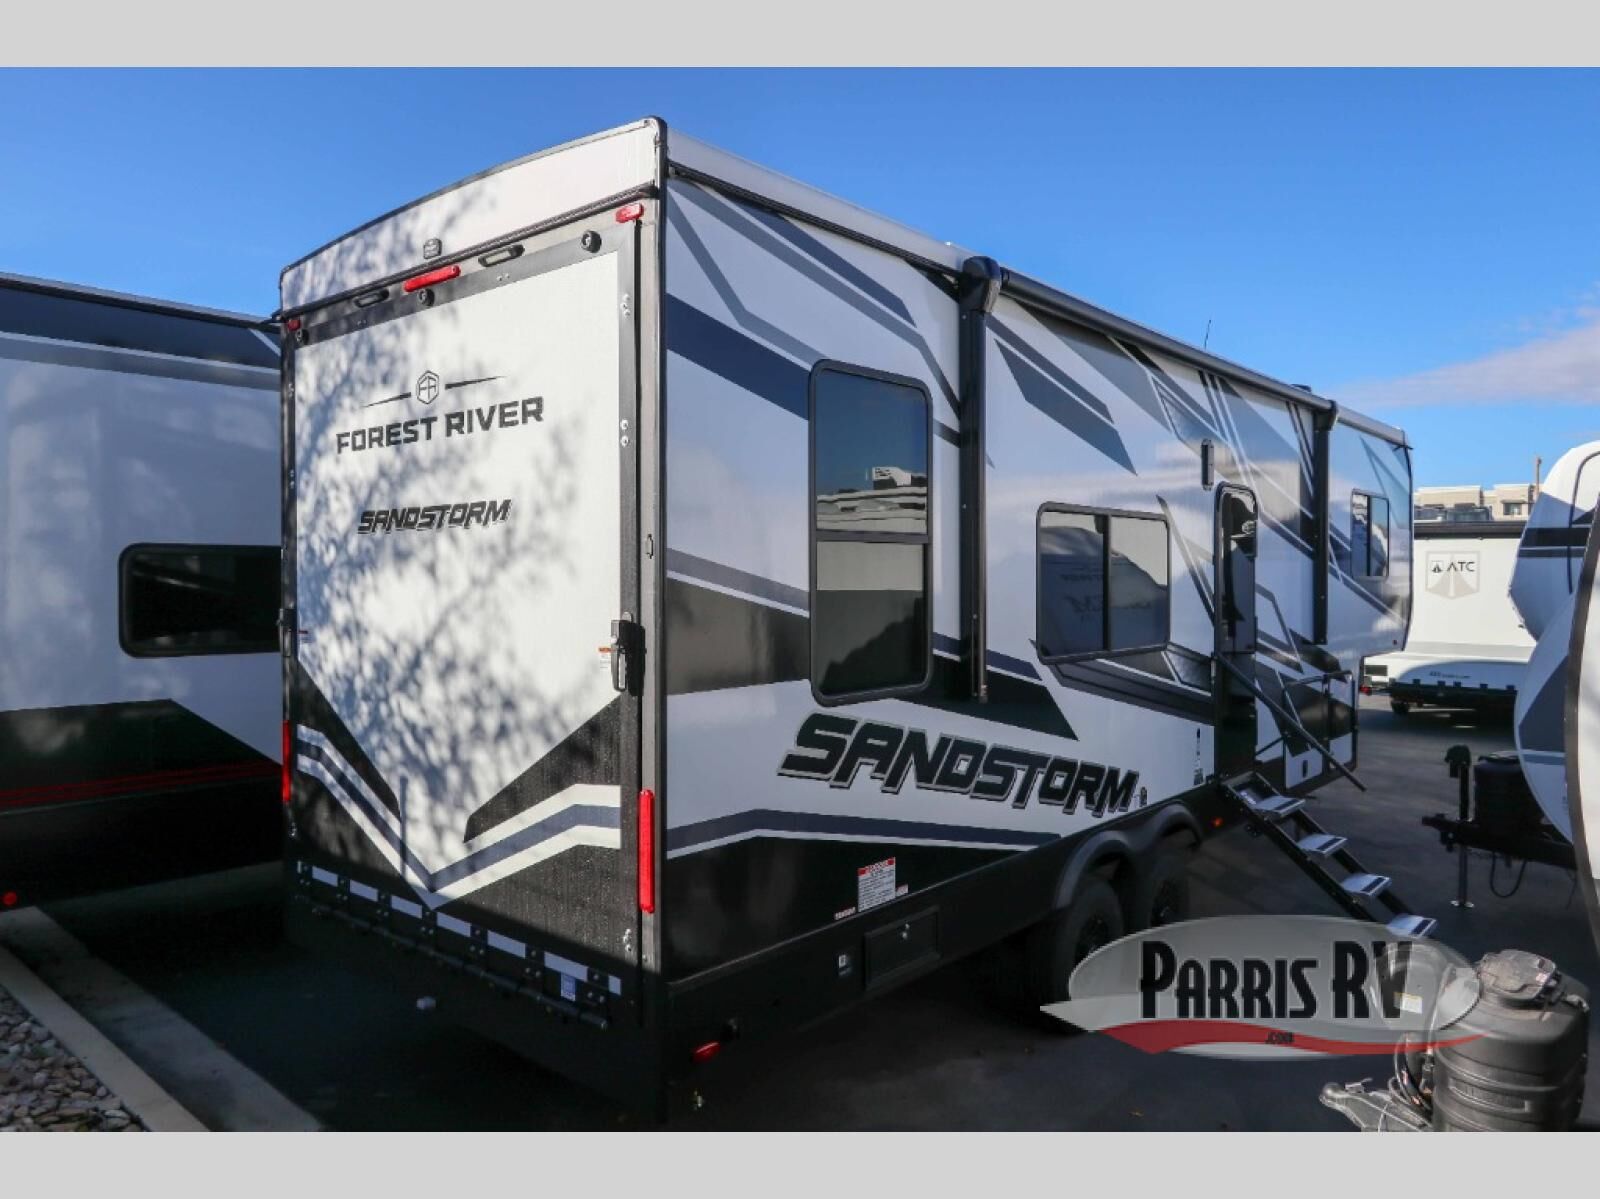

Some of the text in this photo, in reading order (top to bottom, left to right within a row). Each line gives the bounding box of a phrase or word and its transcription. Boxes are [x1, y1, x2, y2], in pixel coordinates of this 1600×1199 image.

[335, 396, 544, 455] FOREST RIVER
[357, 499, 512, 535] SANDSTORM
[1446, 561, 1475, 572] ATC
[776, 712, 1140, 818] SANDSTORM
